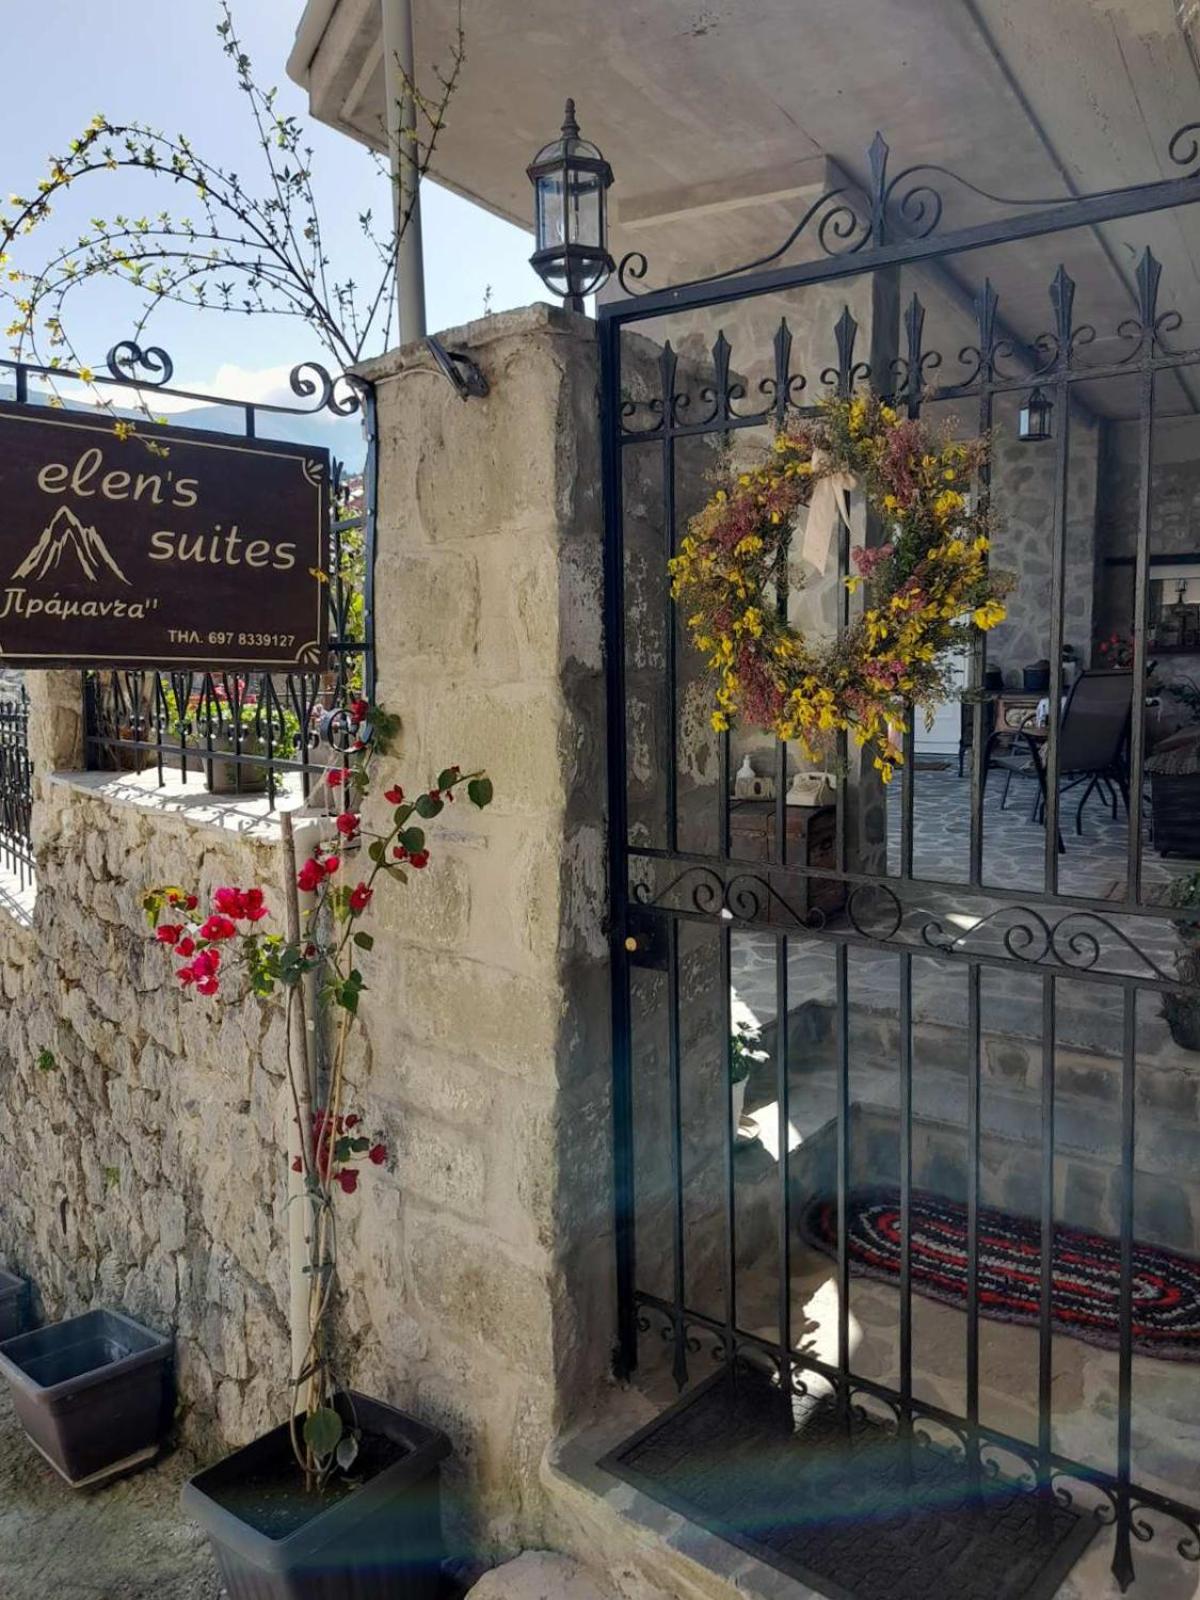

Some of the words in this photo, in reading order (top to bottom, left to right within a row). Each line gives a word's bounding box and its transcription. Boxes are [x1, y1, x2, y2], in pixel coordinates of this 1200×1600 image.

[37, 448, 199, 507] elen's
[149, 524, 297, 570] suites
[208, 631, 234, 645] 697
[238, 632, 295, 647] 8339127
